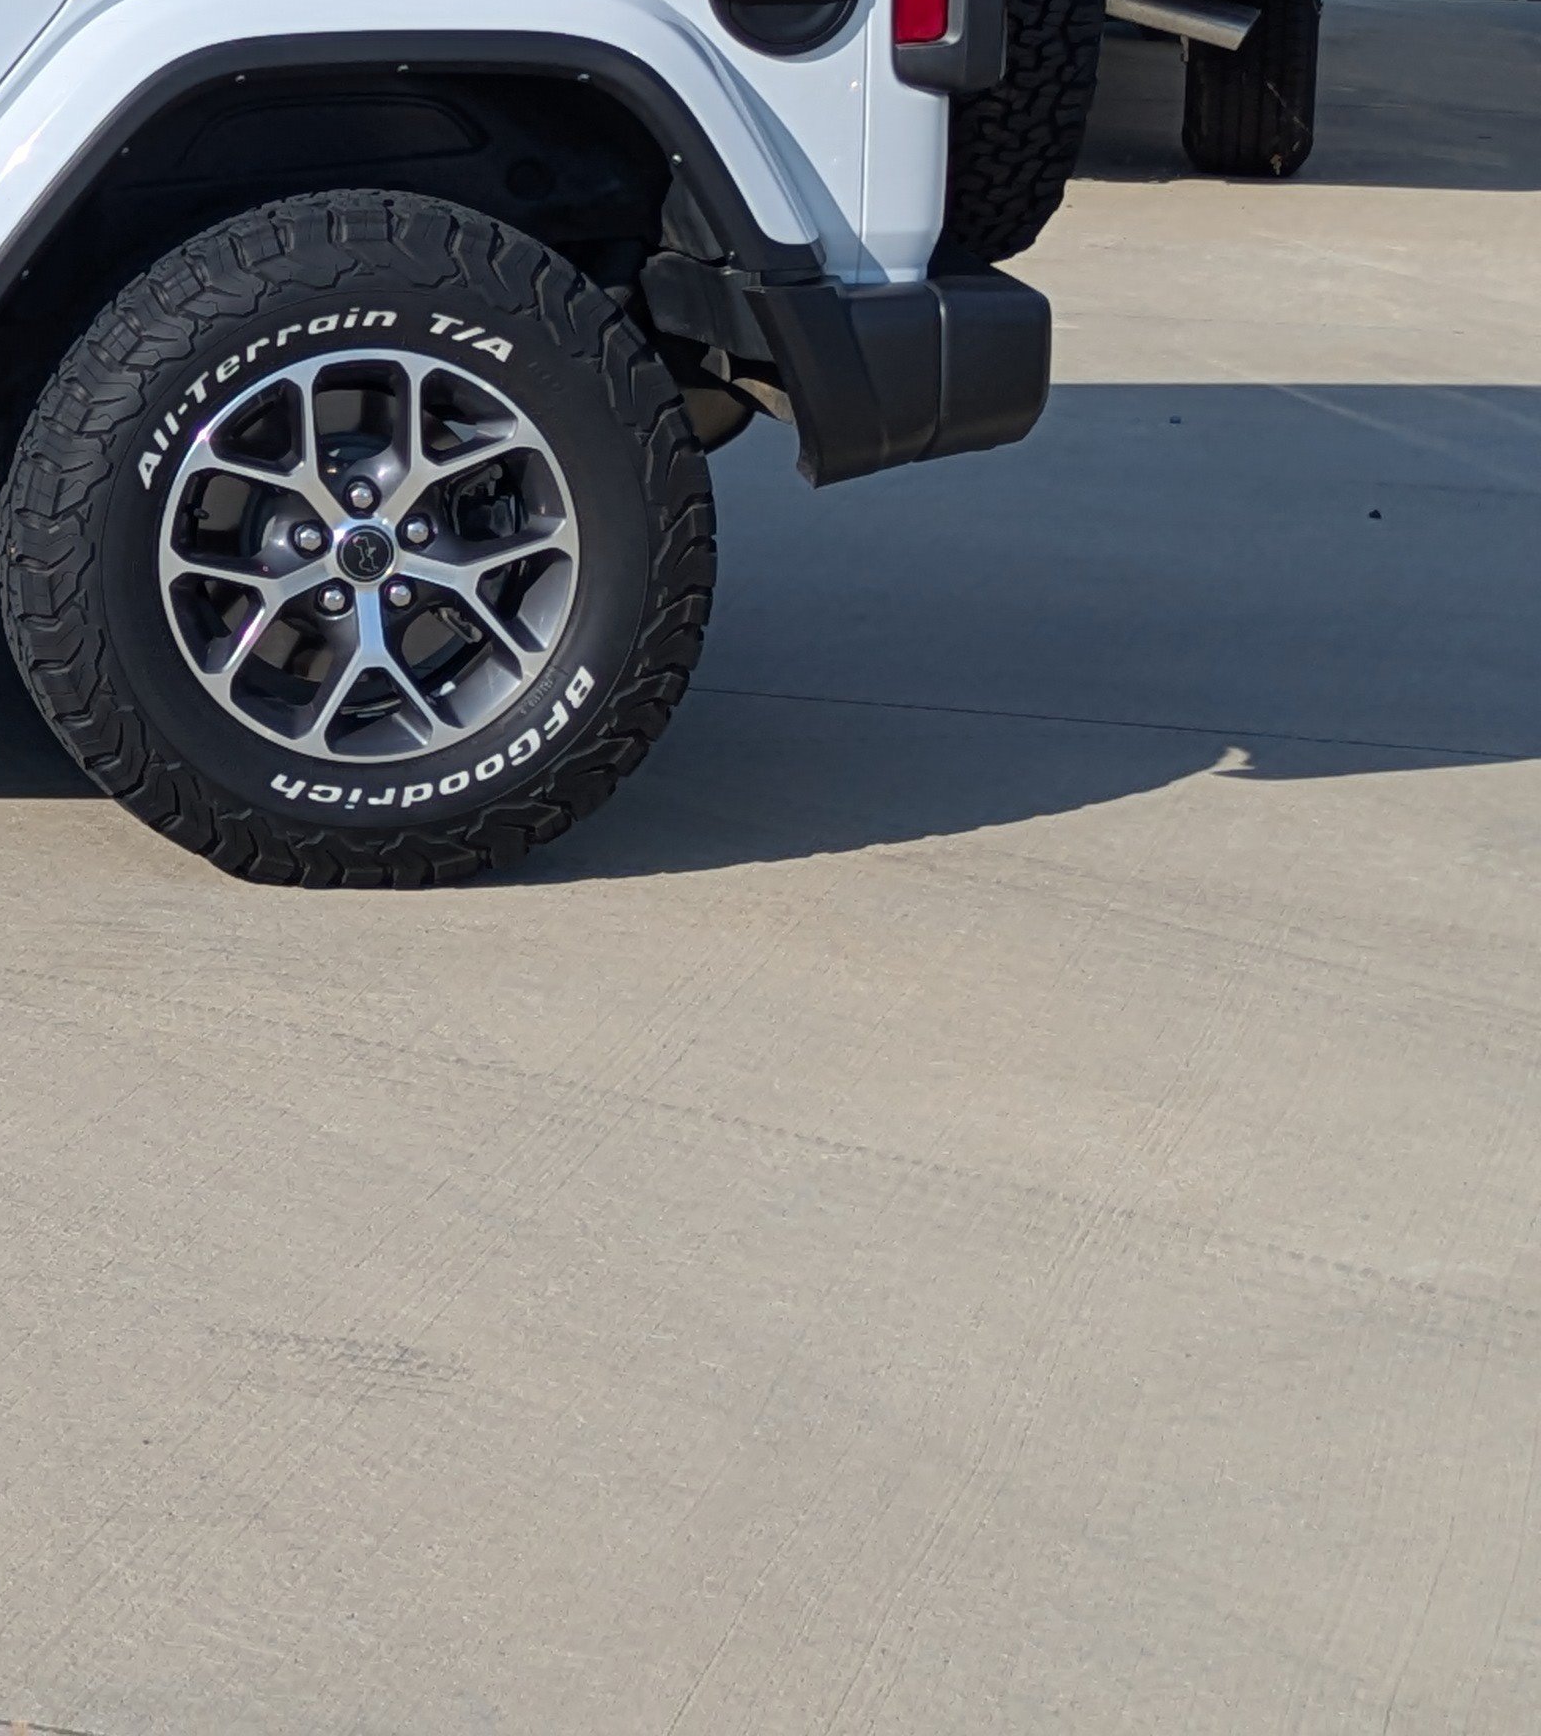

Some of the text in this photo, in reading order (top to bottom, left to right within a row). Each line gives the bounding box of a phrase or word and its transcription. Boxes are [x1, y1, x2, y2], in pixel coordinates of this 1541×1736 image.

[136, 306, 516, 491] All-Terrain T/A
[270, 665, 596, 810] BFGoodrich
